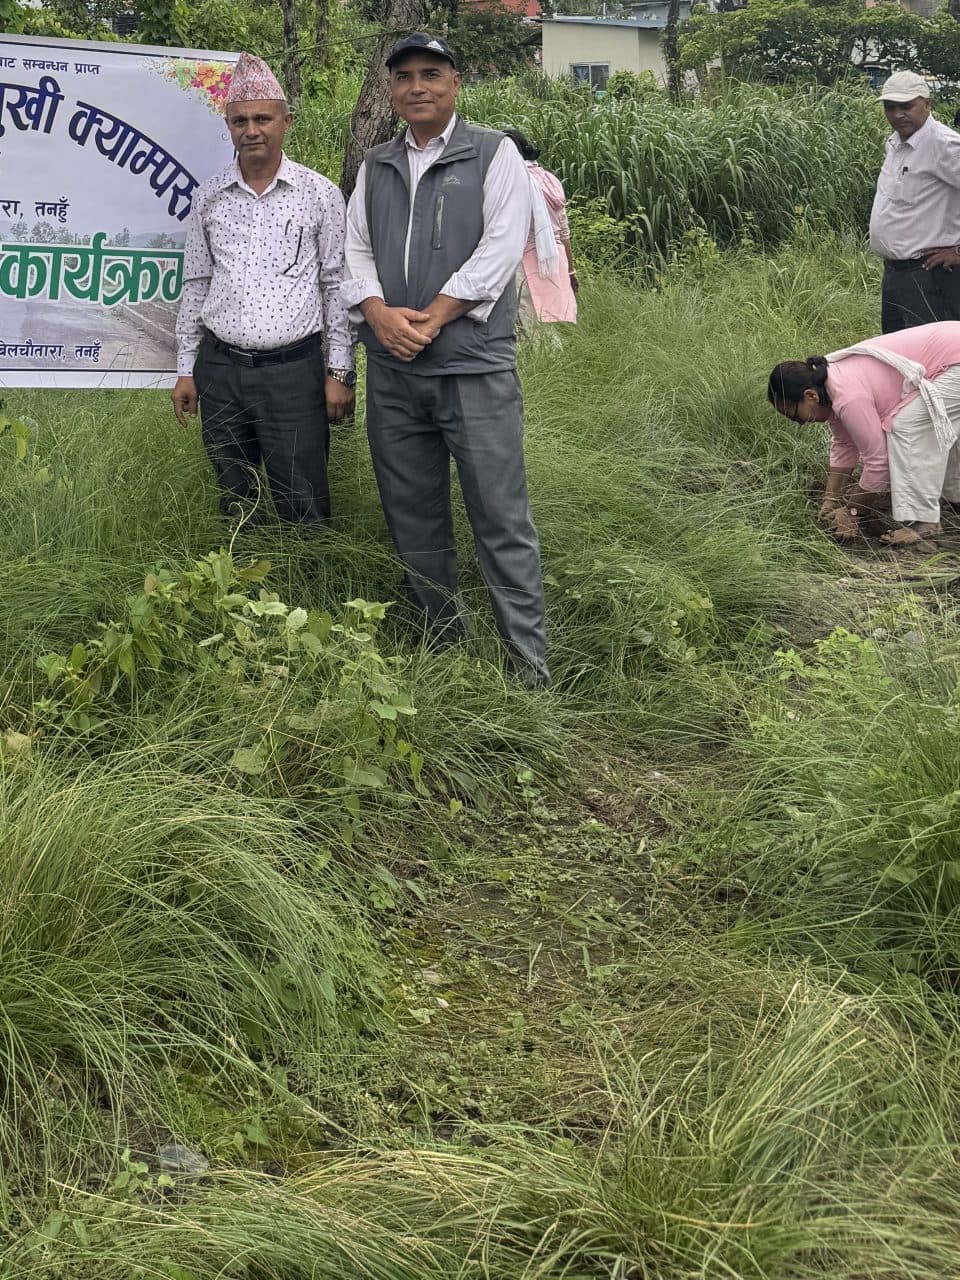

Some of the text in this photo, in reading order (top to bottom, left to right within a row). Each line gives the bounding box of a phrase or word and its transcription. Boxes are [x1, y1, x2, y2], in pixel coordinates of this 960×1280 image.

[75, 63, 101, 75] प्राप्त
[69, 100, 200, 222] क्याम्पस
[35, 196, 70, 222] तनहुँ
[74, 340, 102, 362] तनहुँ
